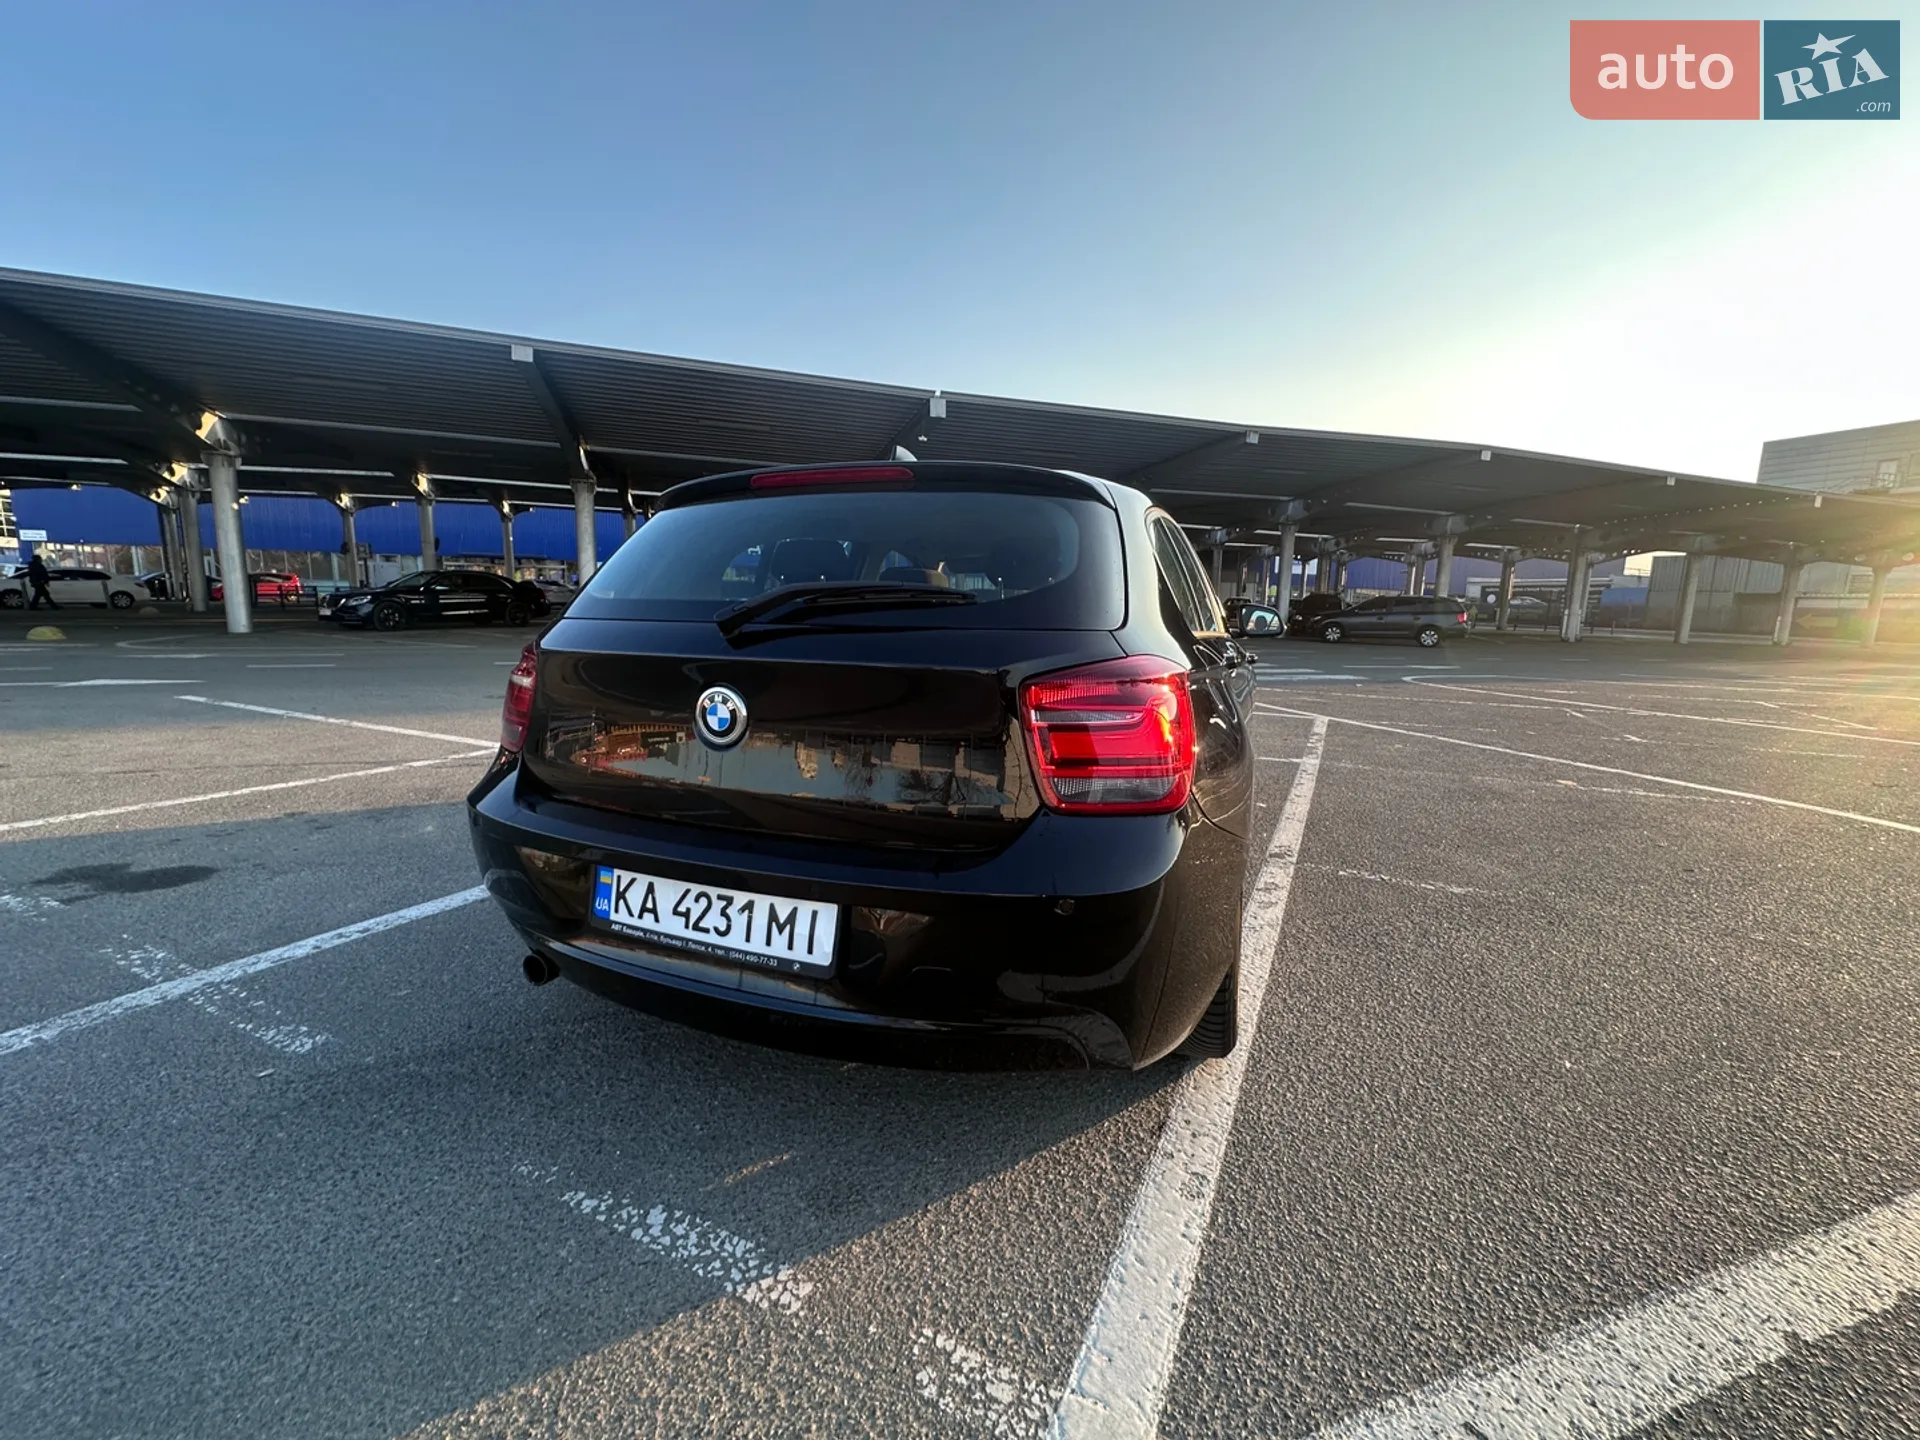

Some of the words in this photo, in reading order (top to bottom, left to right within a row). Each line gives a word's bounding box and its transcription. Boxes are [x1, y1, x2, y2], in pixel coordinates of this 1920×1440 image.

[703, 694, 735, 710] BMW
[595, 896, 610, 912] UA
[614, 874, 660, 923] KA
[672, 888, 755, 943] 4231
[765, 902, 818, 955] MI
[728, 951, 745, 961] (044)
